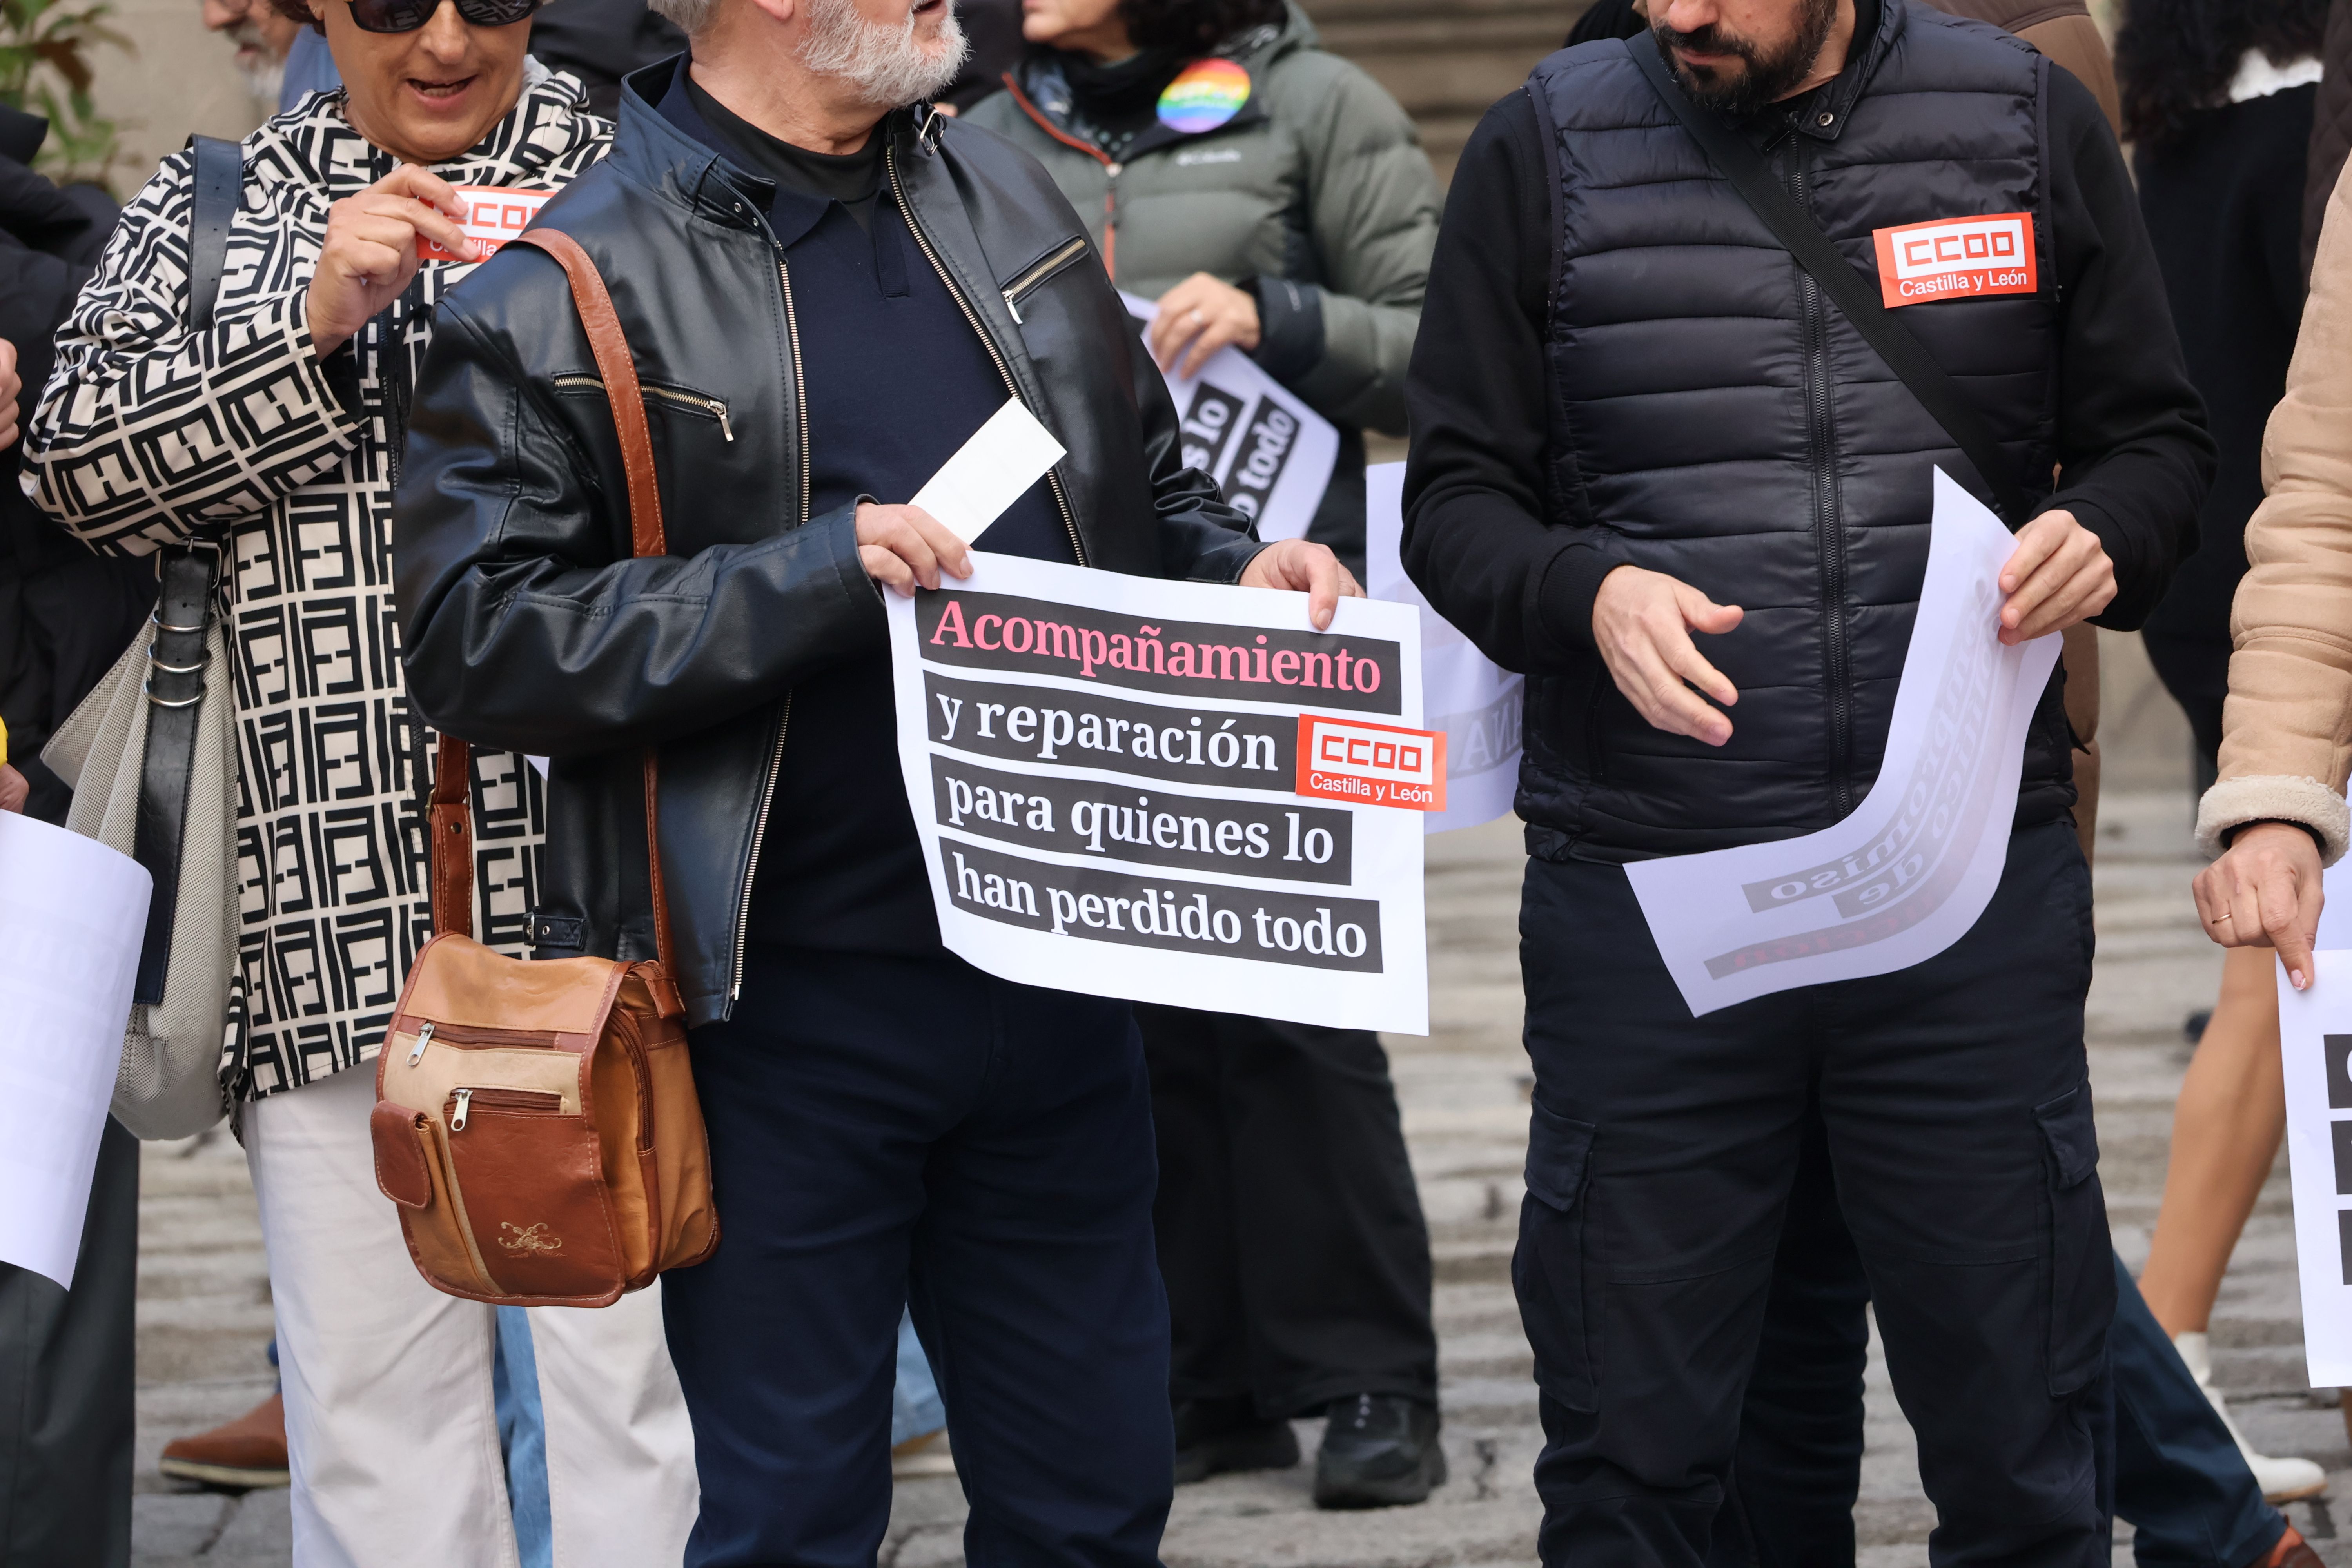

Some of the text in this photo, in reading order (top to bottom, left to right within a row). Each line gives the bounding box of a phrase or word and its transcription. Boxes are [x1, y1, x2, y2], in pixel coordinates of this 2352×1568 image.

[1899, 269, 2027, 297] Castilla y León
[1904, 231, 2015, 267] CCOO
[1233, 408, 1295, 491] todo
[929, 601, 1381, 693] Acompañamiento
[936, 693, 1279, 771] y reparación
[1321, 735, 1422, 773] CCOO
[945, 776, 1334, 864] para quienes lo
[1310, 773, 1433, 803] Castilla y León
[952, 851, 1367, 958] han perdido todo
